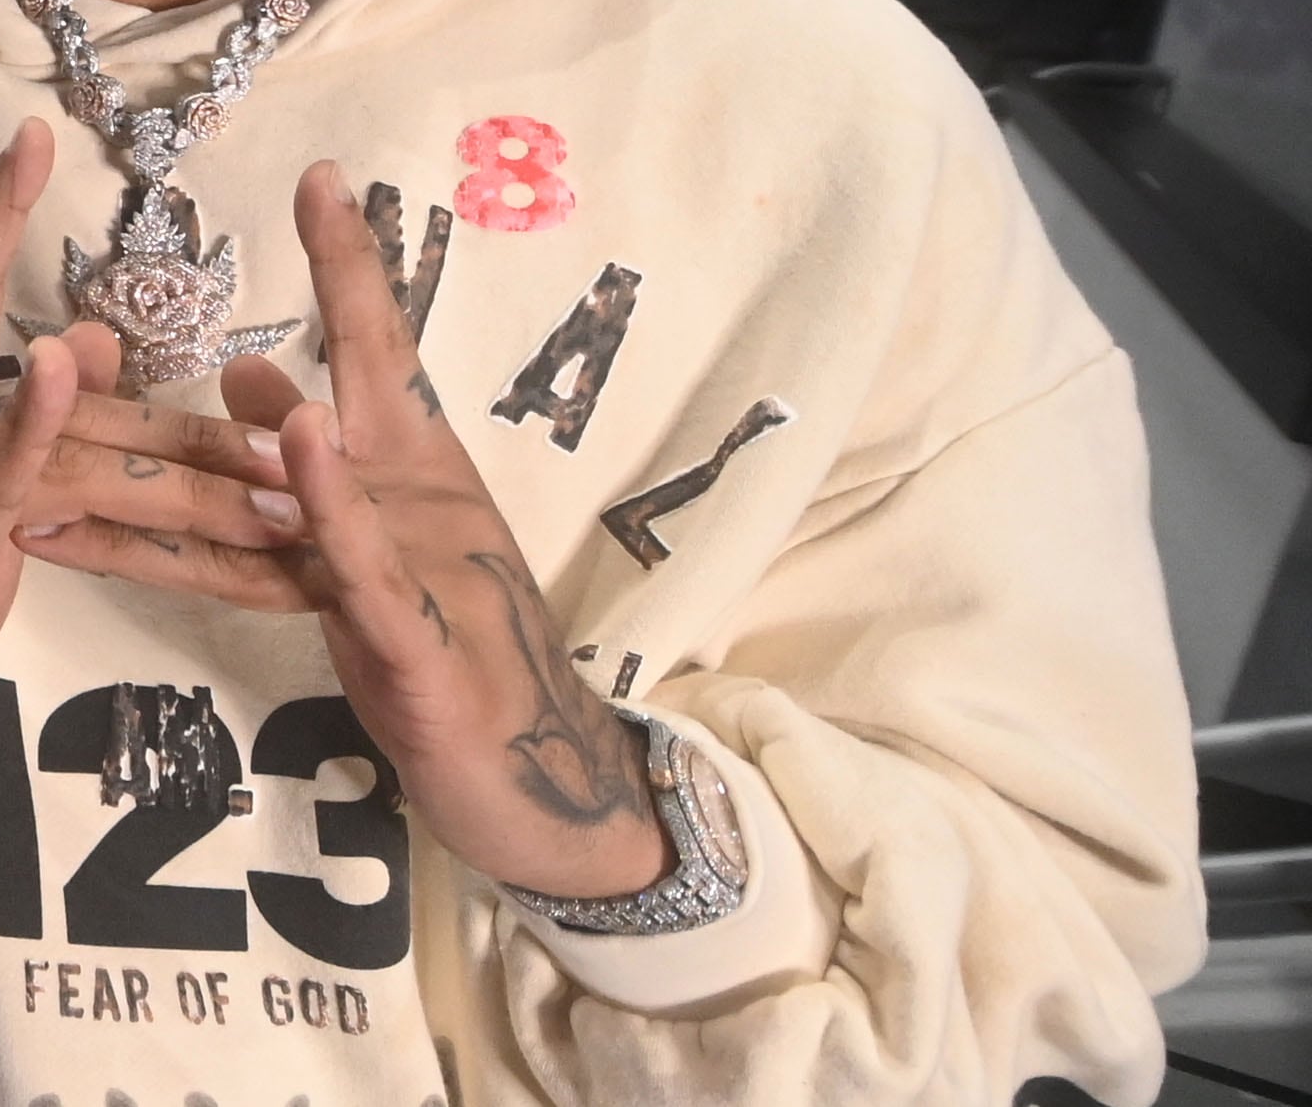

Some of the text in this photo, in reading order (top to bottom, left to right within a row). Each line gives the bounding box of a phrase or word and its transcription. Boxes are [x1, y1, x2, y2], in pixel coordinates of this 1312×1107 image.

[454, 115, 576, 232] 8
[24, 959, 371, 1035] FEAR OF GOD
